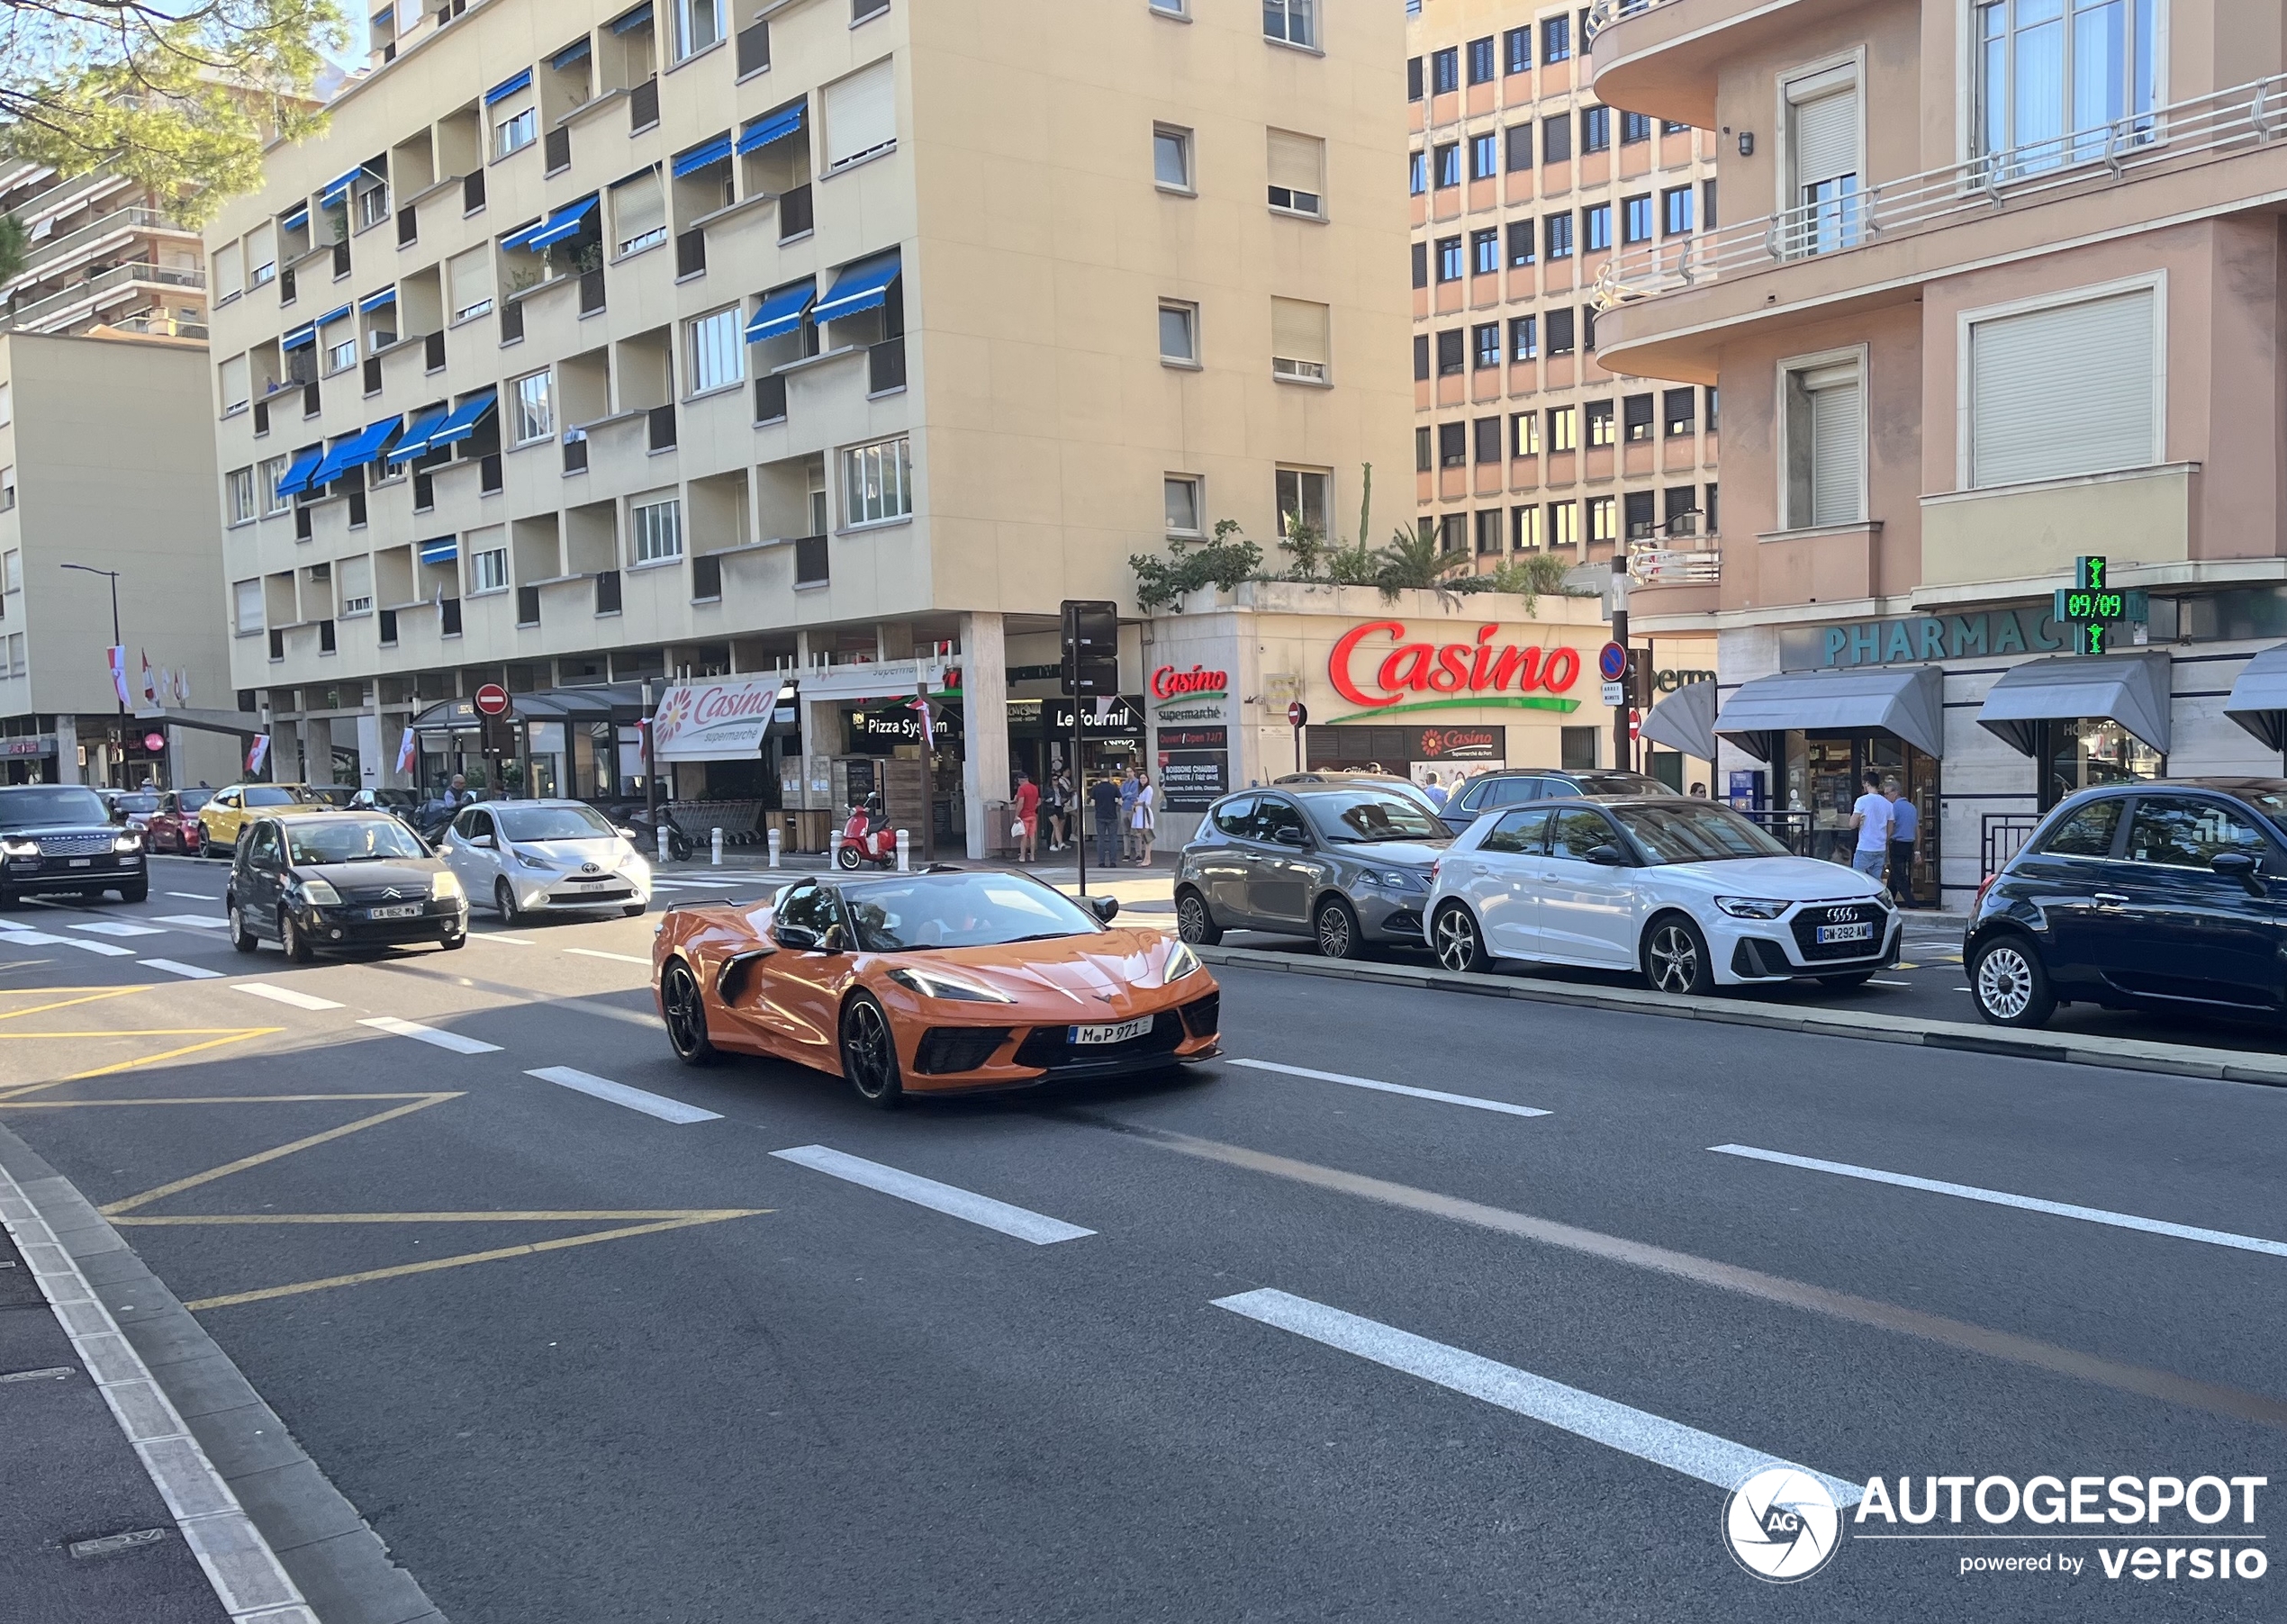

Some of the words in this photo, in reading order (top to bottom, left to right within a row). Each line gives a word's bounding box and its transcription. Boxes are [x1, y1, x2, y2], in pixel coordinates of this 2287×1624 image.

[2068, 594, 2121, 618] 09/09
[1824, 609, 2112, 666] PHARMAC
[1329, 621, 1581, 706] Casino
[1150, 664, 1227, 699] Casino
[693, 683, 773, 726] Casino
[1158, 706, 1221, 722] supermarché
[868, 719, 899, 734] Pizza
[1056, 710, 1074, 726] Le
[704, 728, 758, 743] supermarché
[1443, 729, 1493, 748] Casino
[1116, 1022, 1139, 1040] 971
